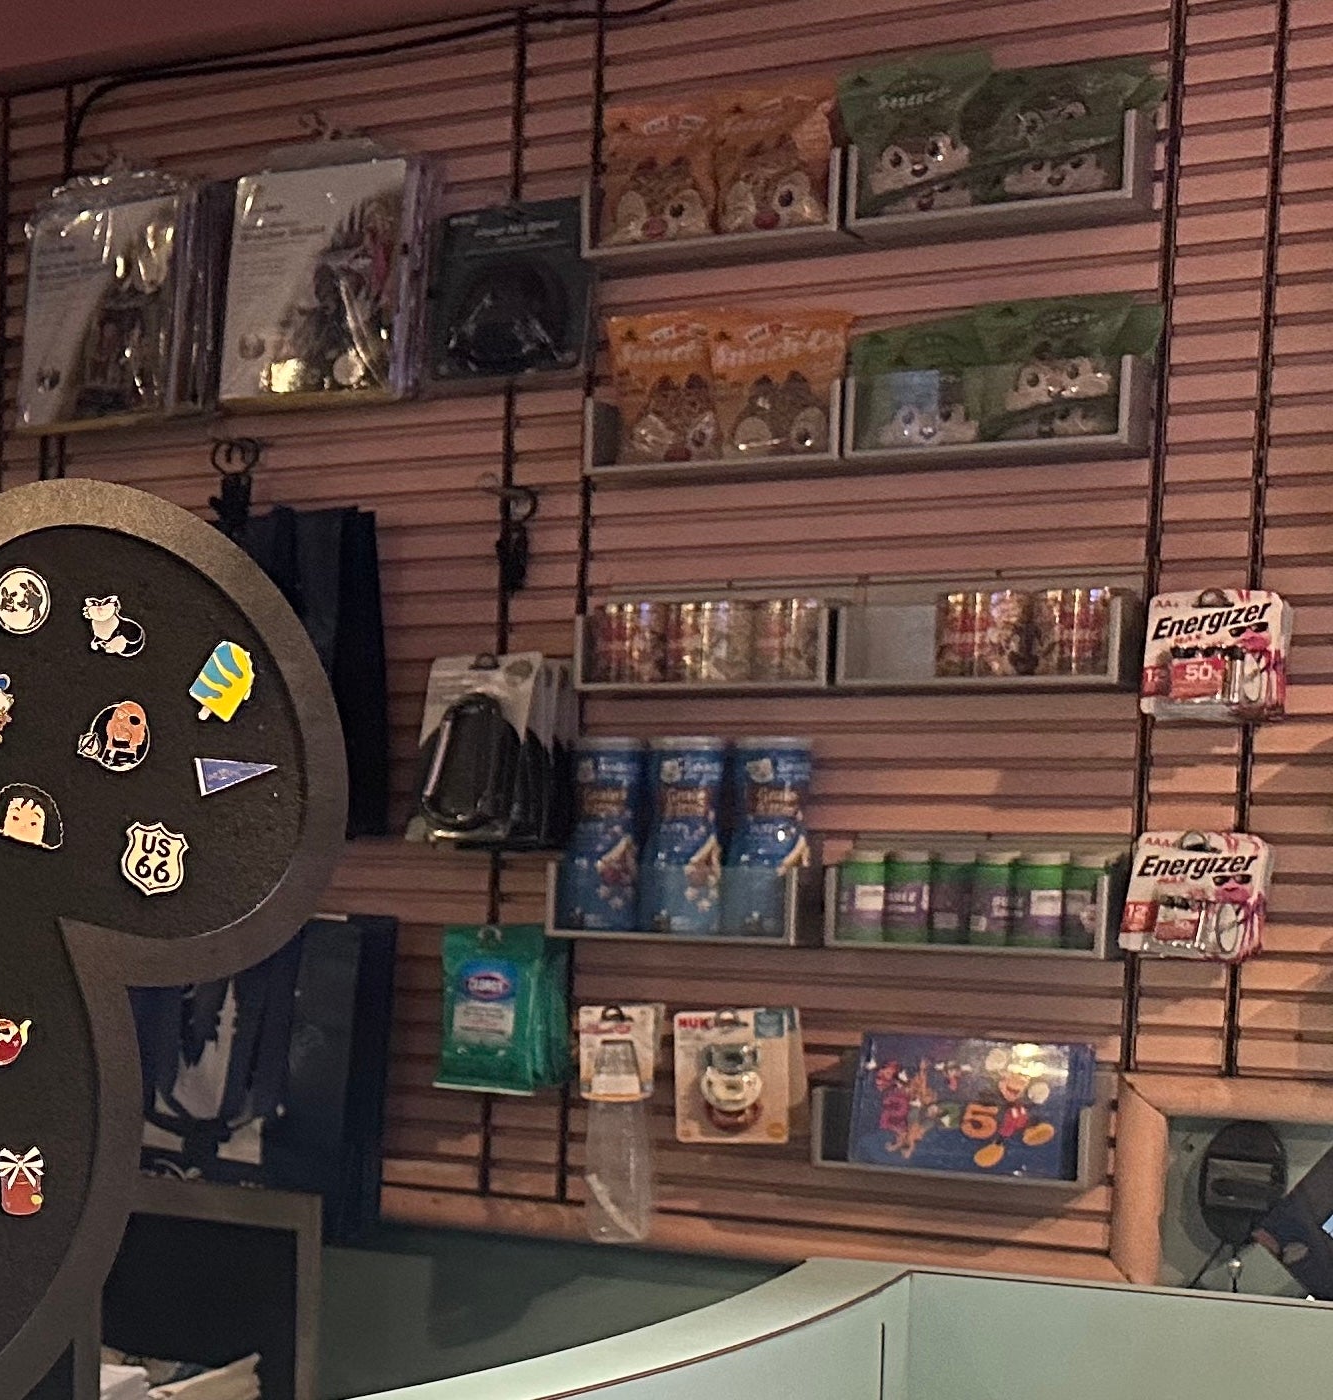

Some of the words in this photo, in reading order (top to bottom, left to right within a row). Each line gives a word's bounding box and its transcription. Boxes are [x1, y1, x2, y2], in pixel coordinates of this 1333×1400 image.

[1151, 602, 1272, 641] Energizer
[141, 833, 172, 858] US
[134, 854, 171, 884] 66
[1136, 855, 1259, 881] Energizer
